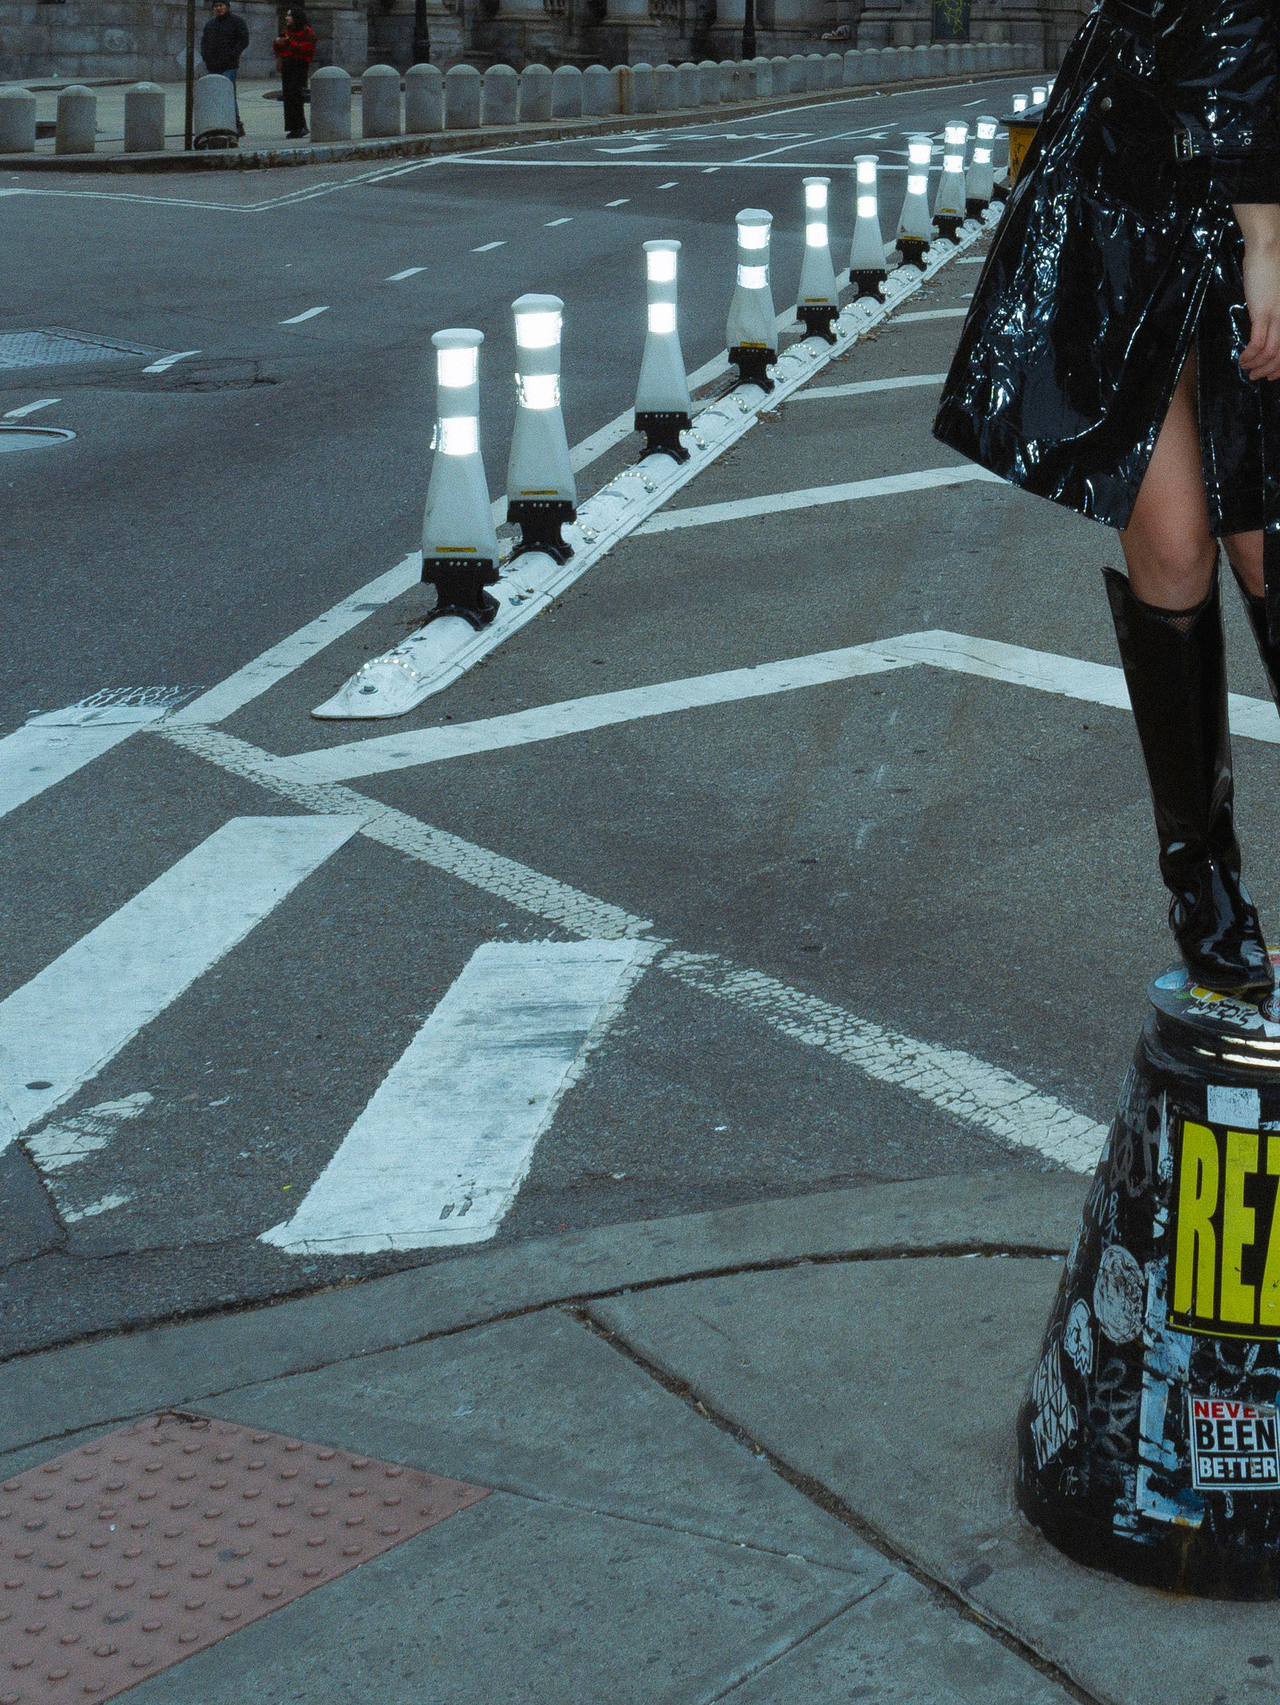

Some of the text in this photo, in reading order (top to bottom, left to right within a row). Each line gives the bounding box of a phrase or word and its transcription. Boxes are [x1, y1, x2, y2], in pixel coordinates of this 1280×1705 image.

[1194, 1401, 1264, 1419] NEVE
[1195, 1419, 1277, 1451] BEEN
[1199, 1457, 1277, 1478] BETTER
